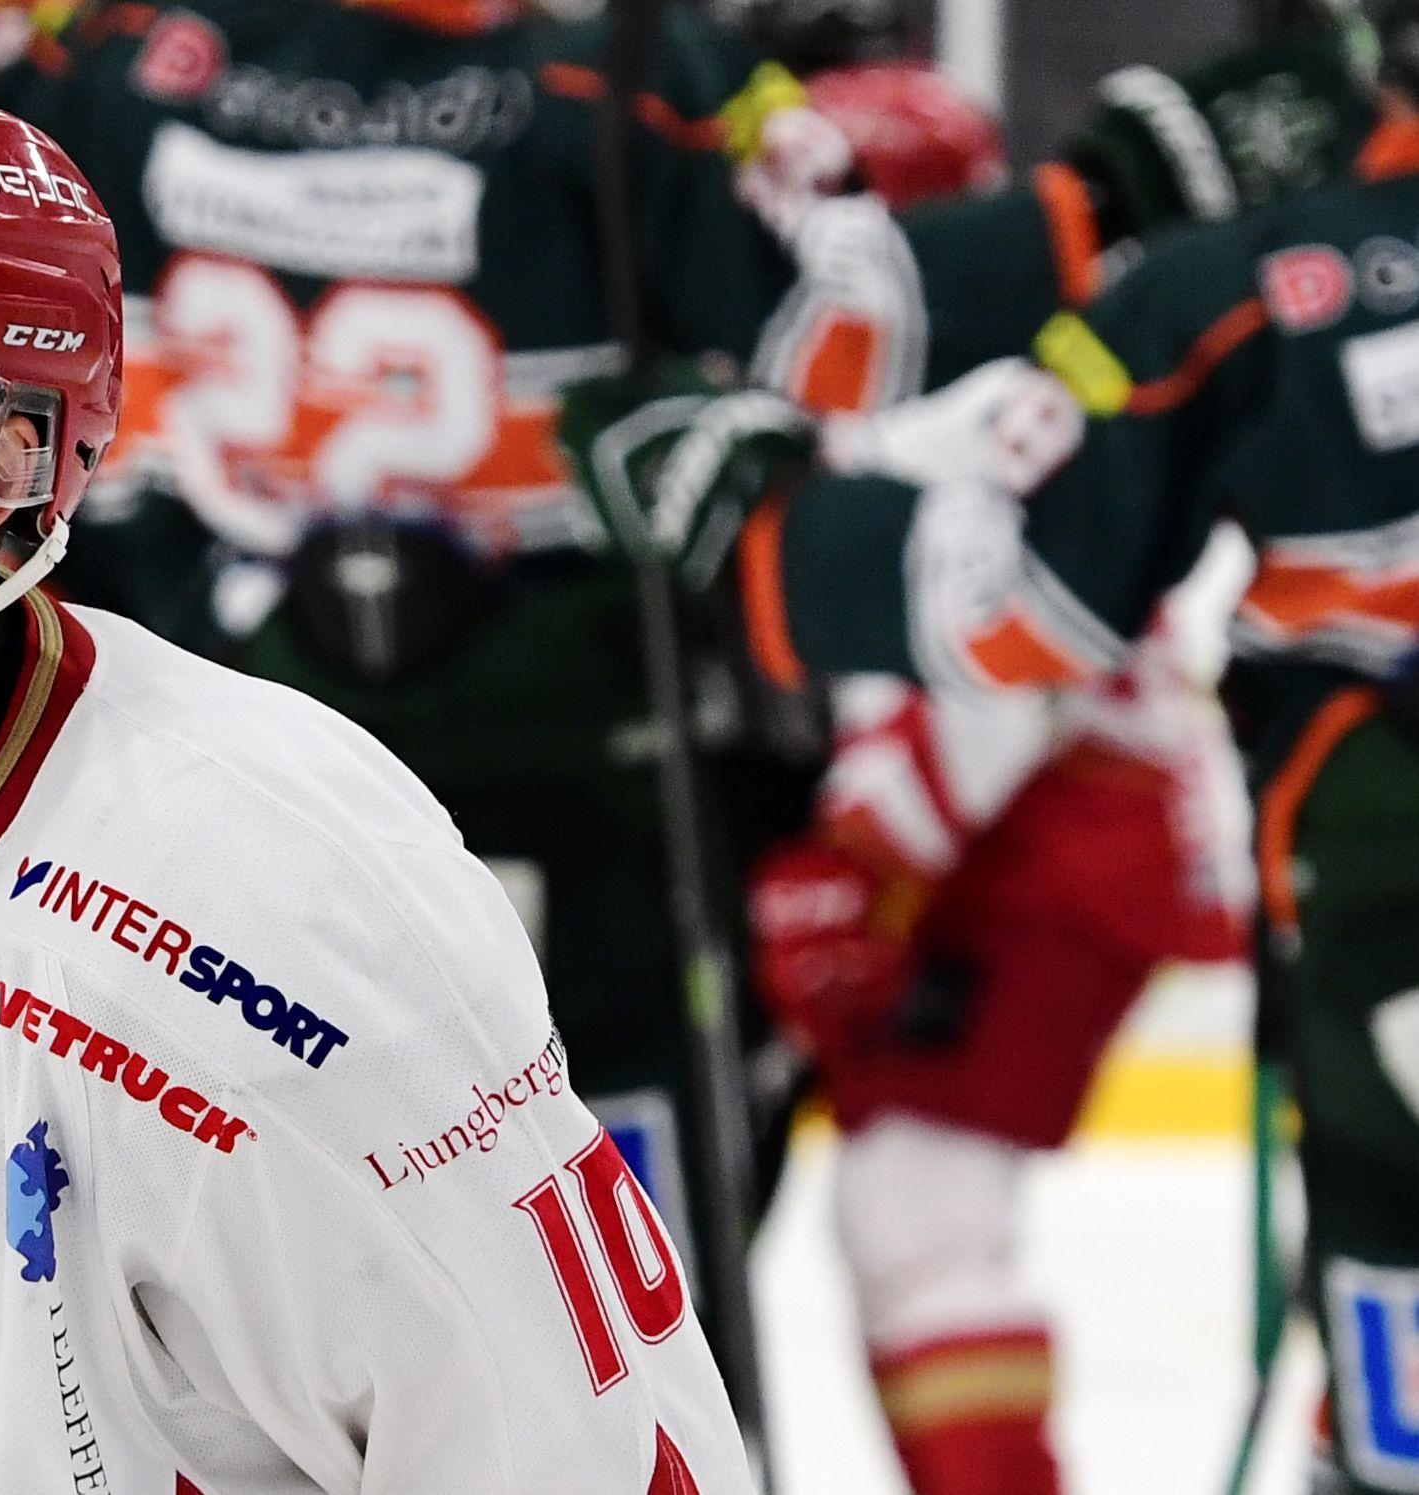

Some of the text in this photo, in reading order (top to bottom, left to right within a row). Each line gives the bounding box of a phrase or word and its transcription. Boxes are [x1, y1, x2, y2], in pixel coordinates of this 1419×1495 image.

[3, 323, 85, 352] CCM
[39, 864, 350, 1070] INTERSPORT
[512, 1122, 687, 1397] 10
